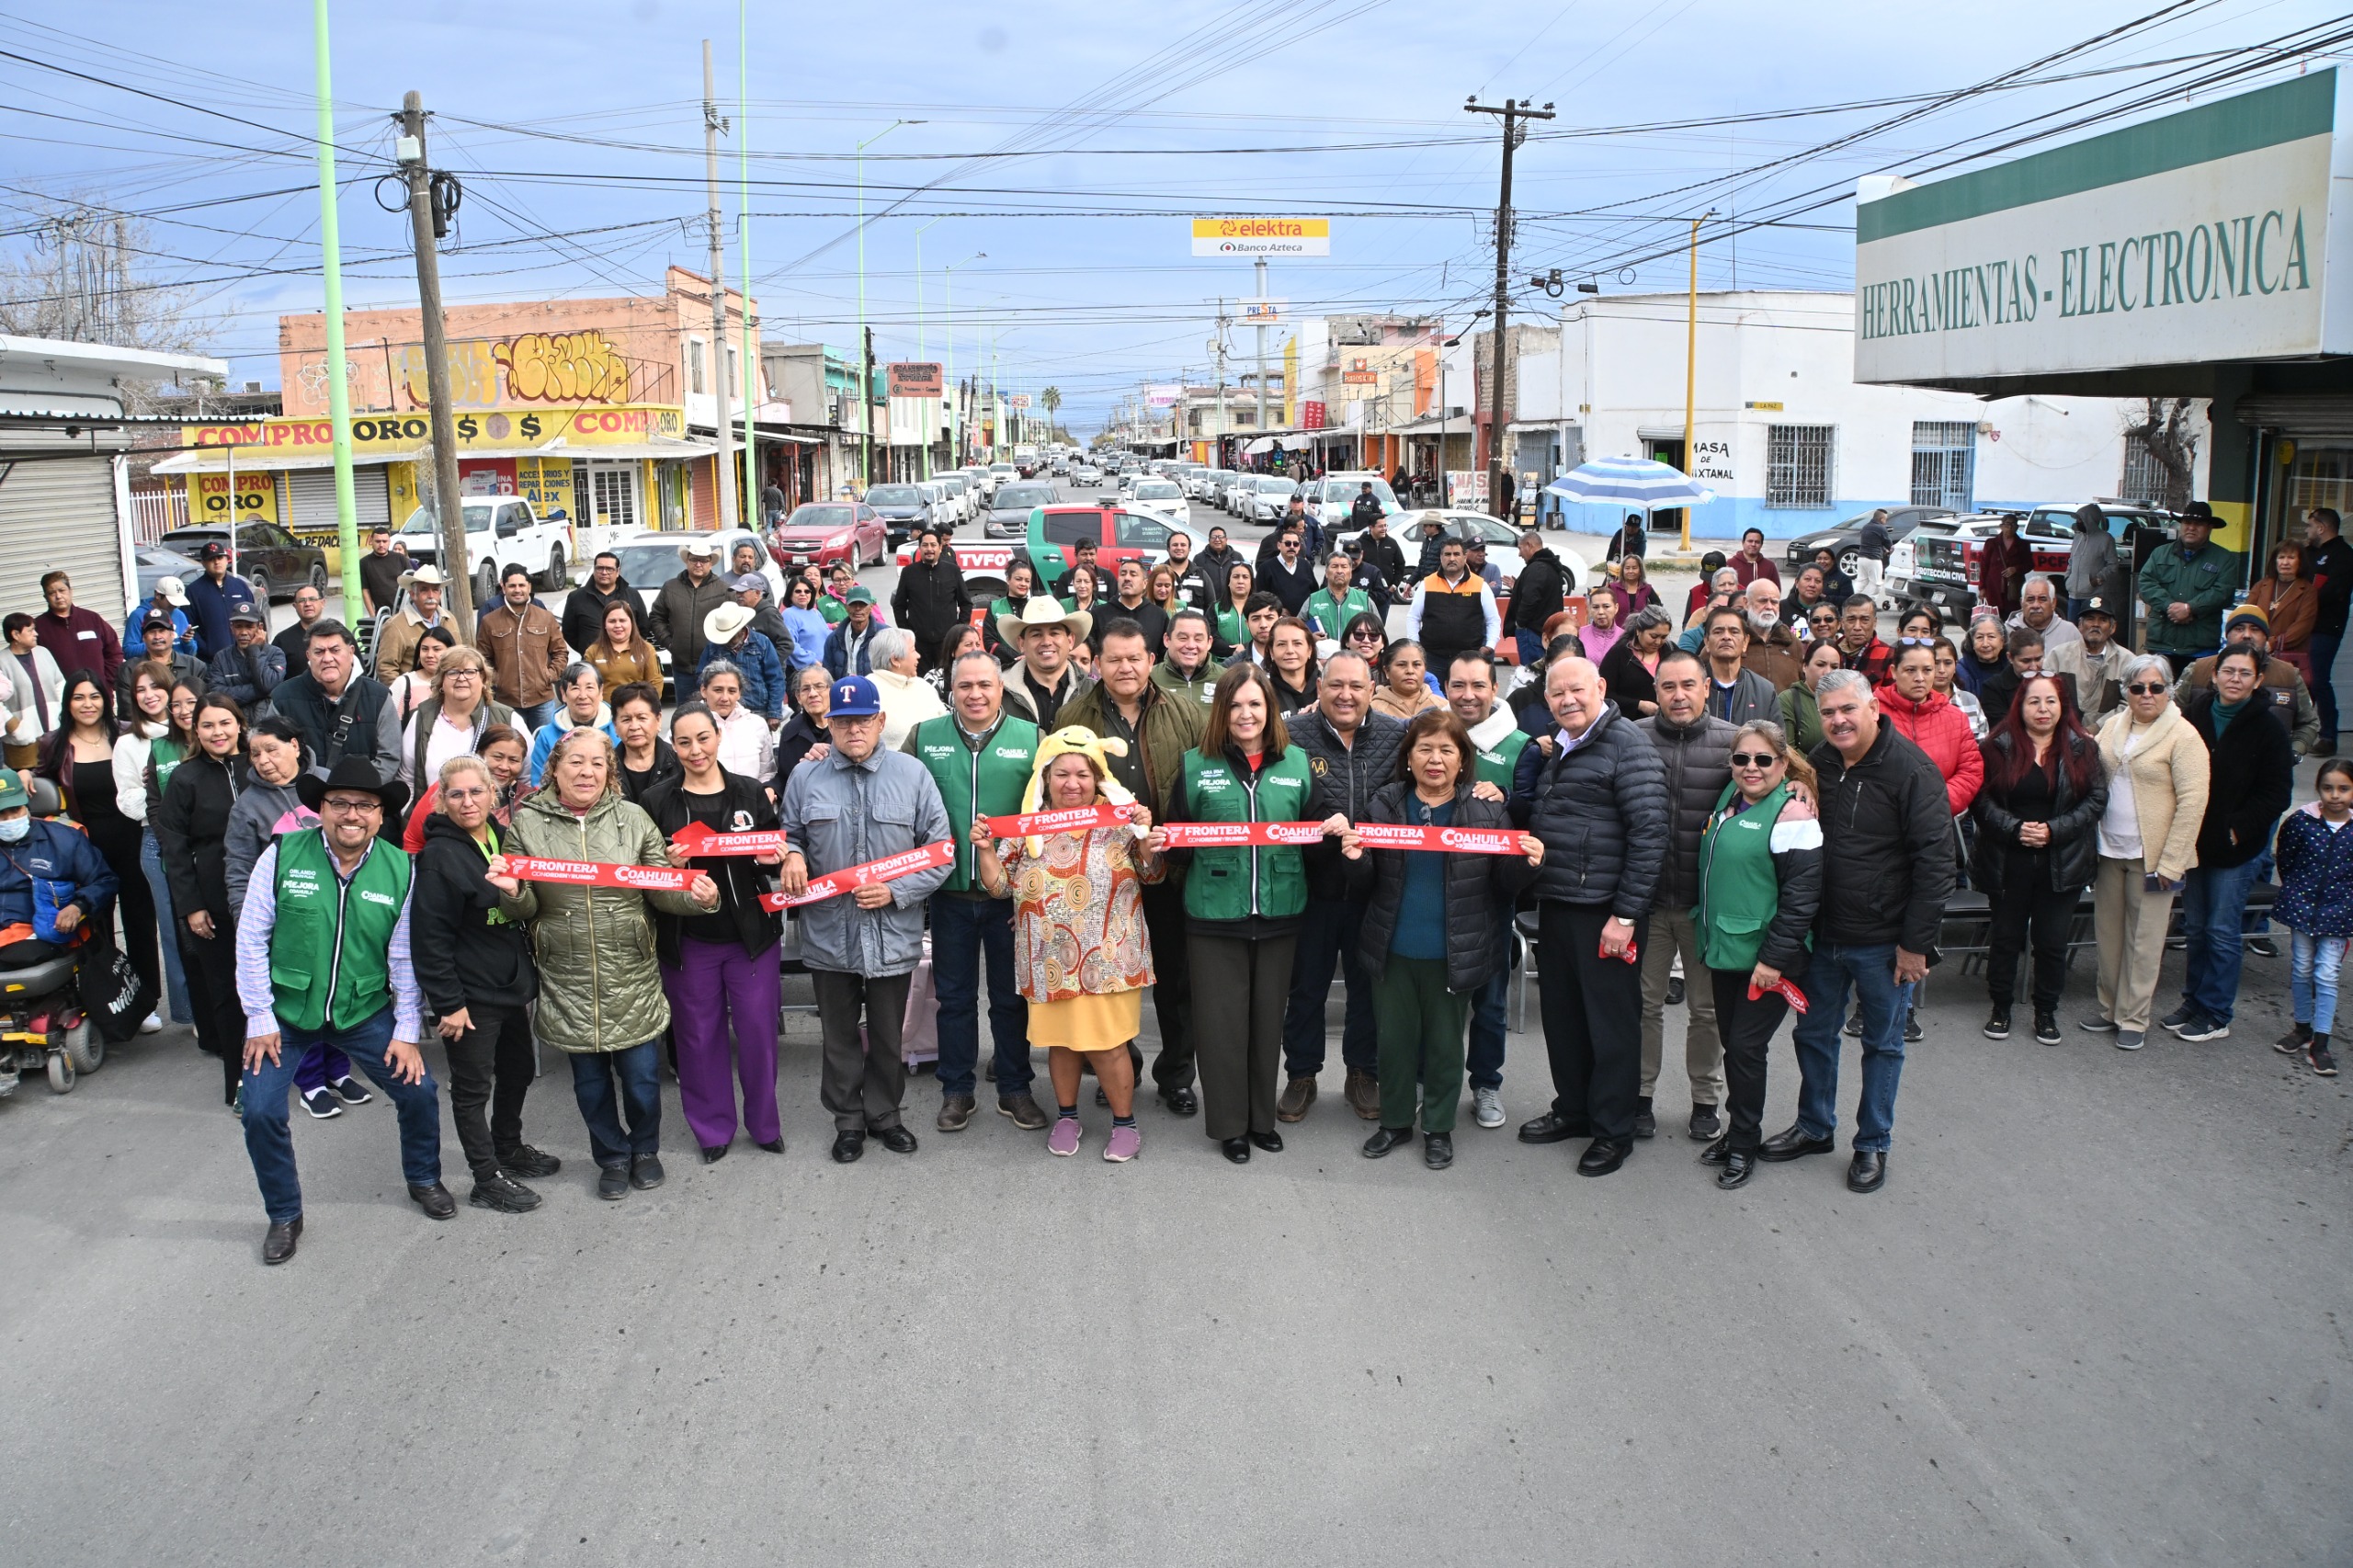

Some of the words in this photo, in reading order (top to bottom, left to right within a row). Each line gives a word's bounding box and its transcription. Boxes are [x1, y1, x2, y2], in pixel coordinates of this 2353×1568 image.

[1240, 220, 1302, 236] elektra
[1237, 244, 1267, 252] Banco
[1269, 244, 1302, 252] Azteca
[1861, 254, 2037, 340] HERRAMIENTAS
[2059, 206, 2310, 318] ELECTRONICA
[1247, 302, 1277, 314] PRESTA
[352, 419, 427, 441] ORO
[660, 412, 678, 433] ORO
[200, 474, 272, 494] COMPRO
[206, 494, 265, 512] ORO
[529, 489, 560, 503] Alex
[1916, 566, 1951, 580] PROTECCIÓN
[1951, 572, 1968, 582] CIVIL
[840, 685, 856, 703] T
[1034, 808, 1099, 825] FRONTERA
[1185, 825, 1251, 836] FRONTERA
[1358, 826, 1425, 838] FRONTERA
[1440, 829, 1510, 846] COAHUILA
[719, 834, 782, 846] FRONTERA
[870, 849, 931, 874] FRONTERA
[529, 860, 598, 874] FRONTERA
[614, 866, 684, 882] COAHUILA
[283, 880, 320, 892] MEJORA
